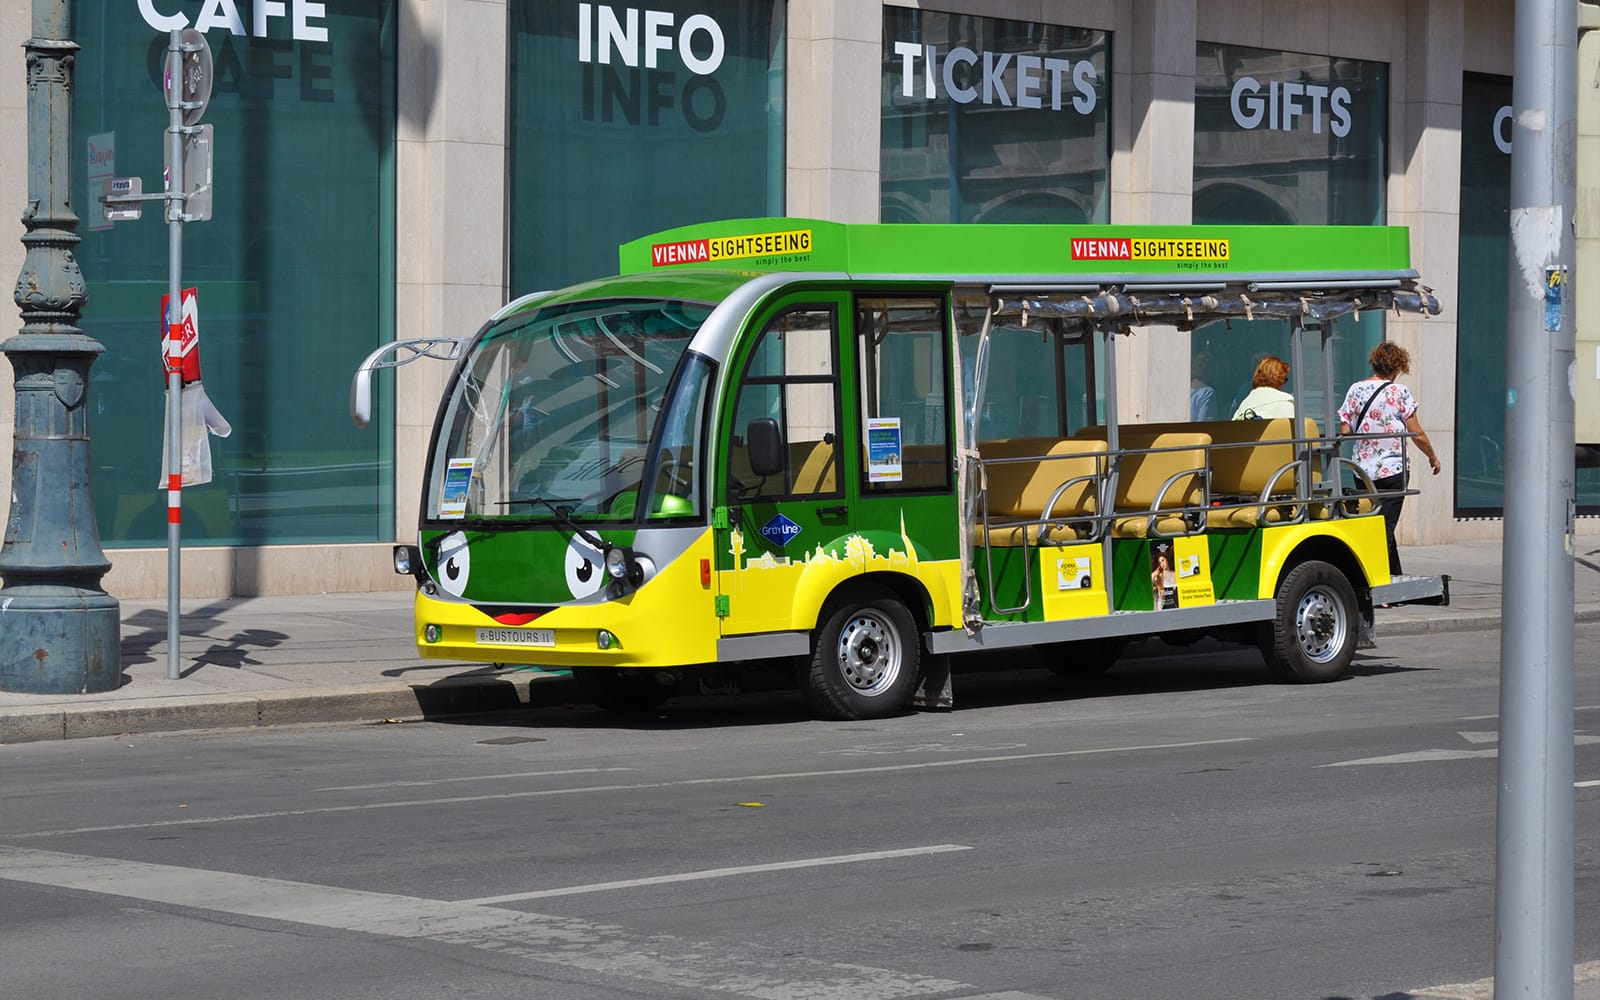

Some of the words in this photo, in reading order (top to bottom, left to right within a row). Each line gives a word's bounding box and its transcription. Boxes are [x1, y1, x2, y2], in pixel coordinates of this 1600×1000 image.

[578, 2, 725, 75] INFO
[894, 41, 1097, 115] TICKETS
[1230, 76, 1352, 138] GIFTS
[653, 242, 708, 264] VIENNA
[711, 232, 810, 258] SIGHTSEEING
[755, 256, 779, 266] simply
[781, 255, 792, 264] the
[794, 254, 811, 263] best
[1072, 240, 1130, 257] VIENNA
[1133, 241, 1228, 258] SIGHTSEEING
[1177, 261, 1199, 270] simply
[1200, 261, 1212, 269] the
[1213, 261, 1229, 269] best
[480, 630, 539, 643] e-BUSTOURS
